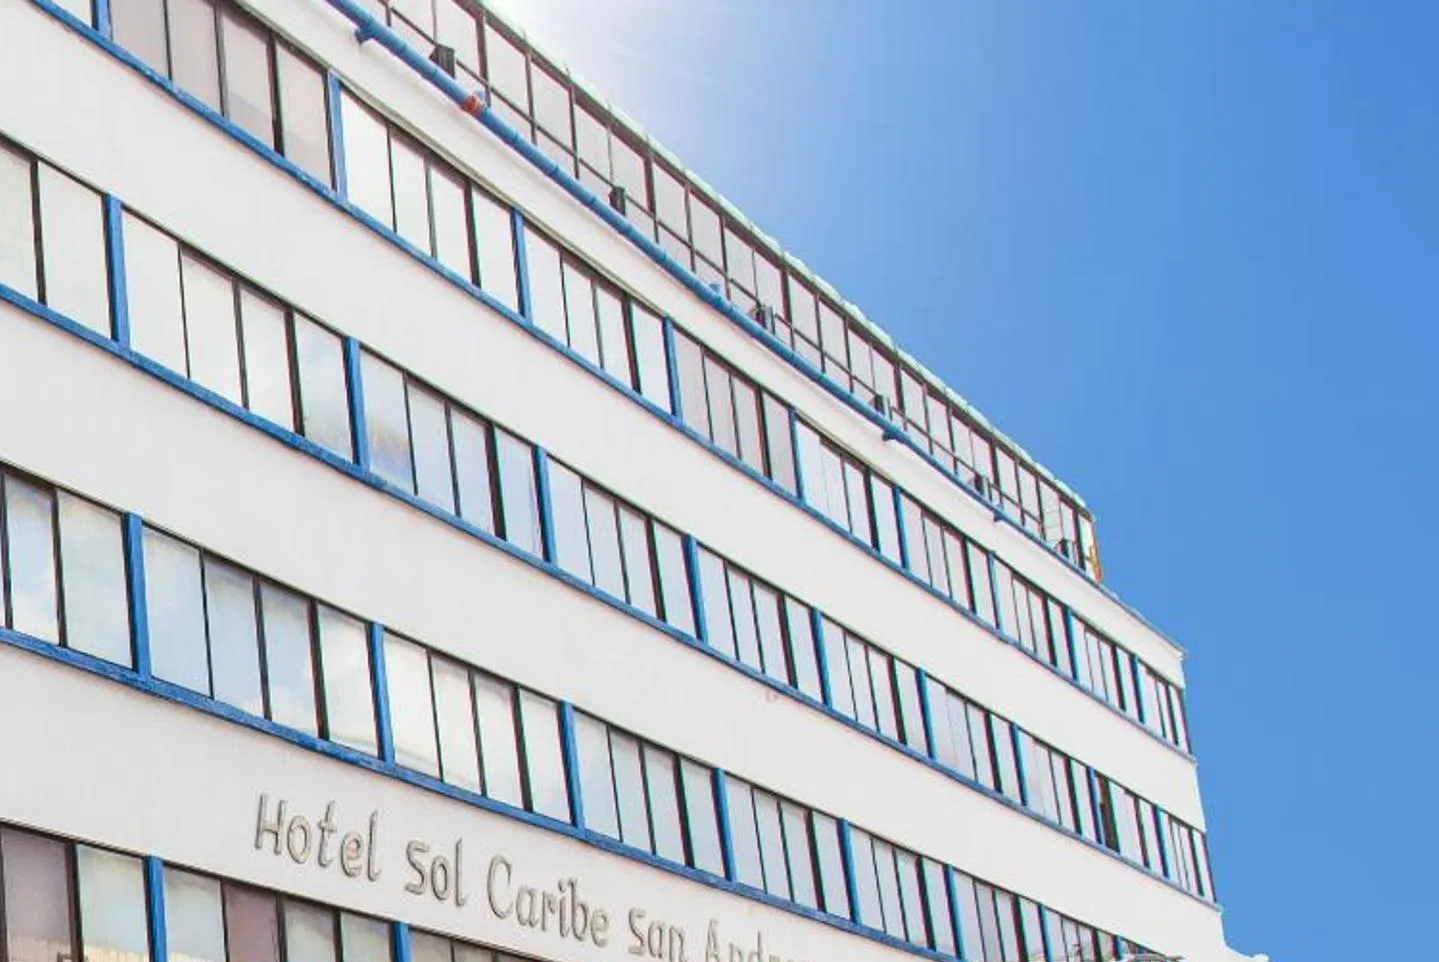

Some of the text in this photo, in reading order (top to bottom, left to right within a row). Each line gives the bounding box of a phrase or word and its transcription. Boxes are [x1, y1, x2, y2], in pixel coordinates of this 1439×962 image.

[254, 793, 383, 882] Hotel
[404, 836, 467, 907] Sol
[486, 854, 610, 948] Caribe
